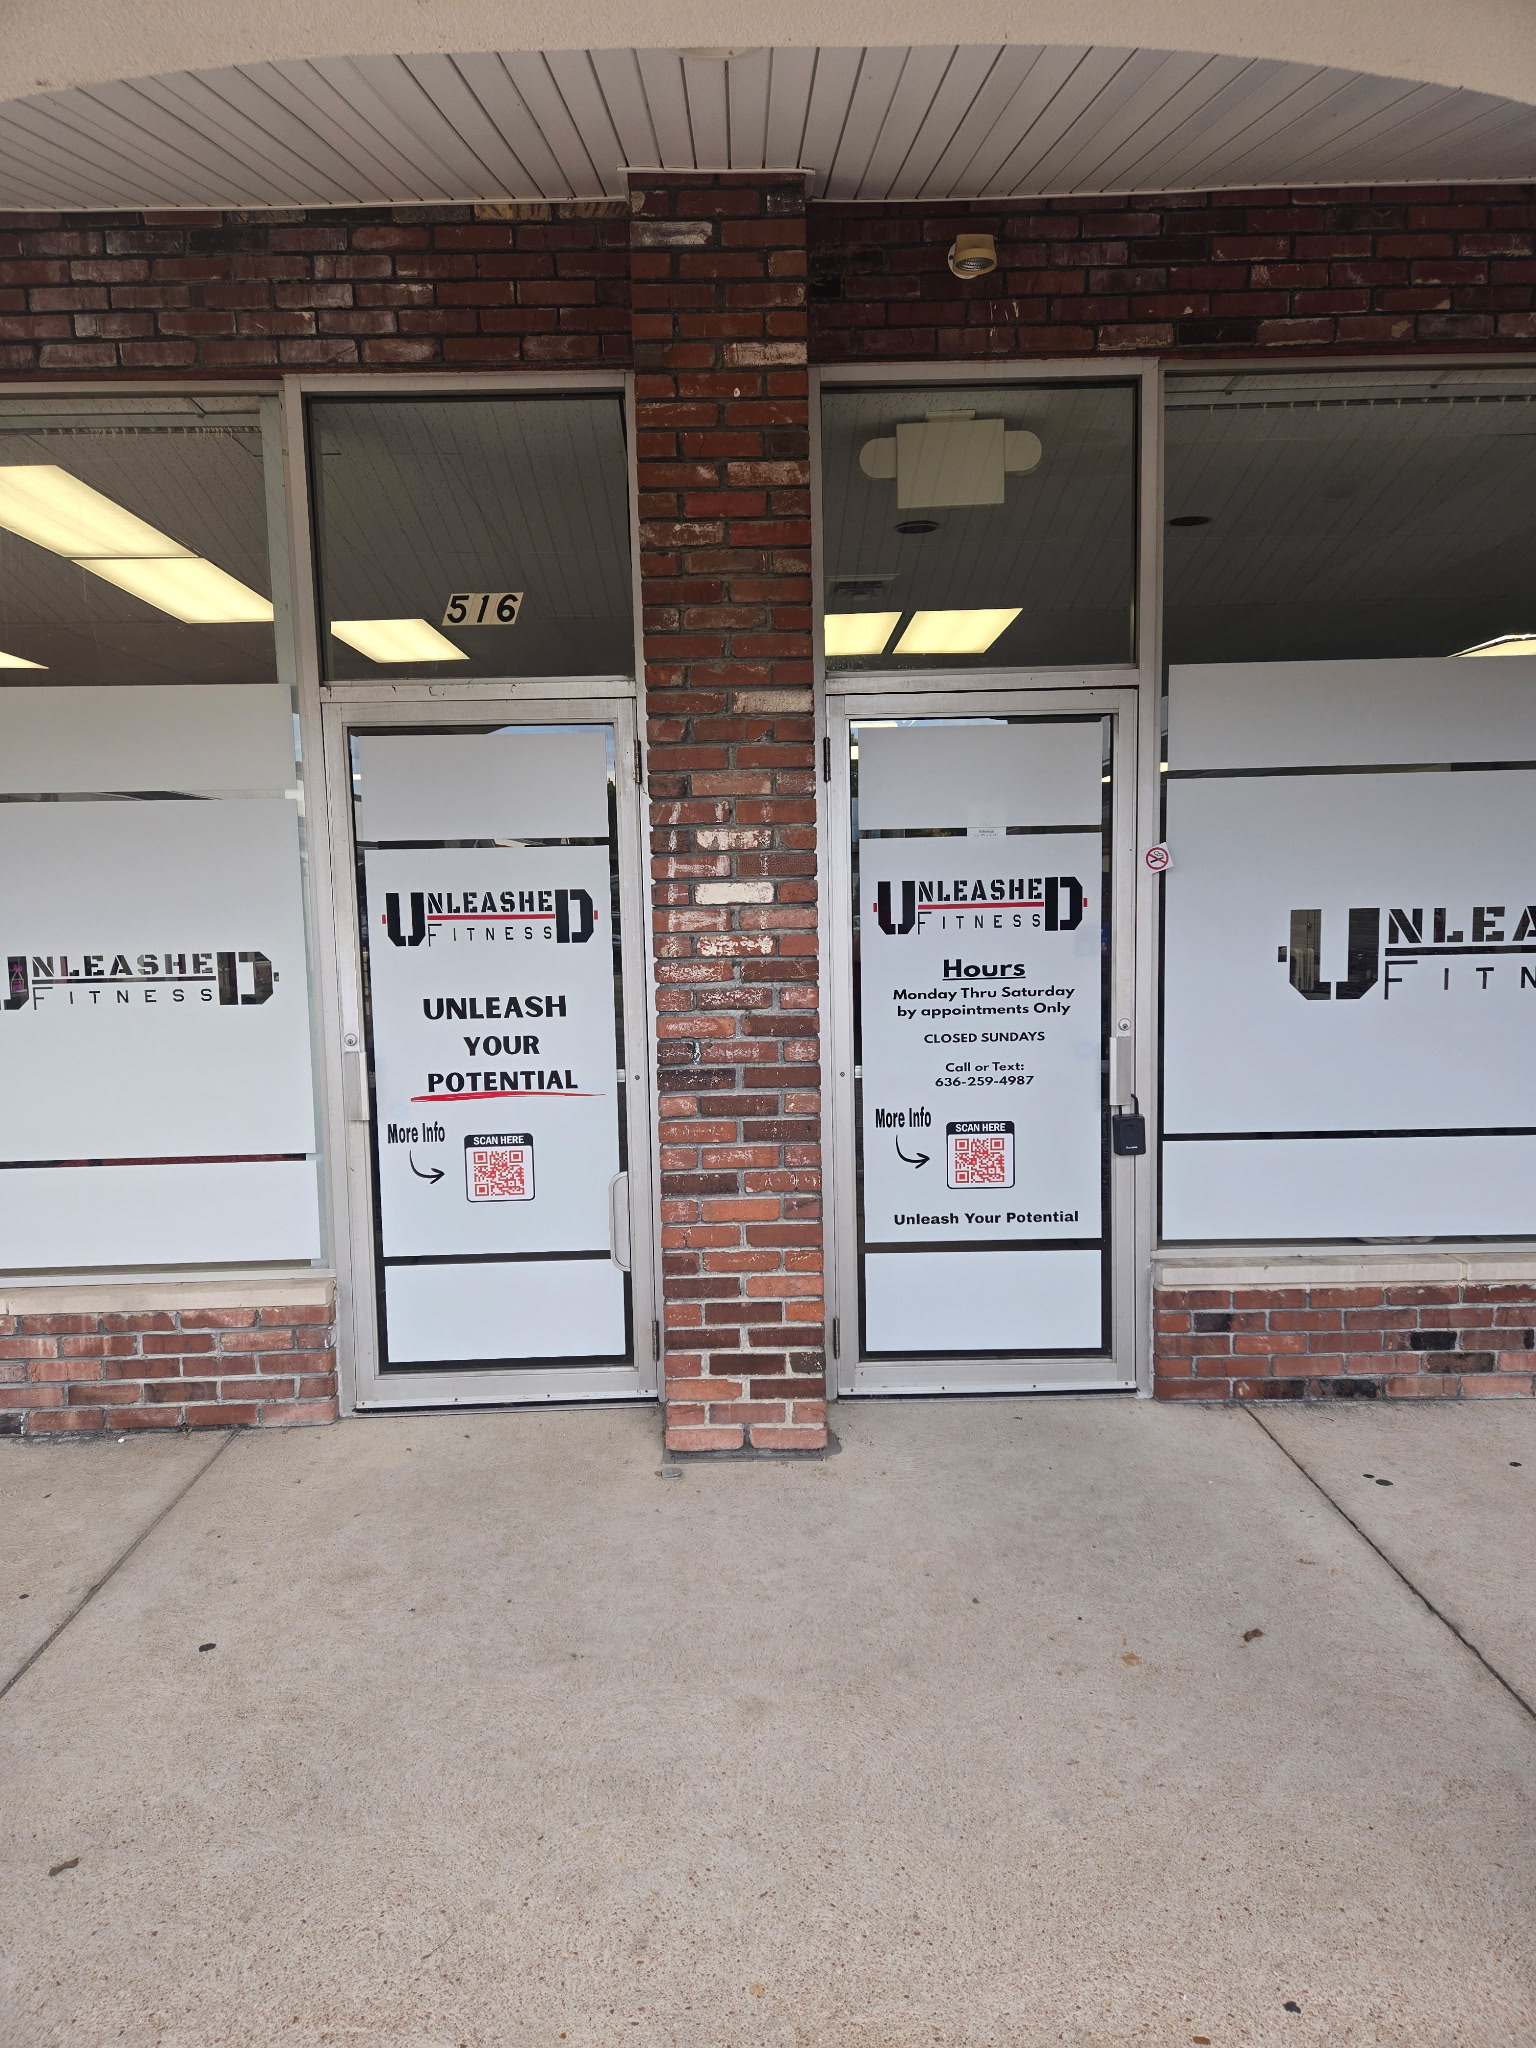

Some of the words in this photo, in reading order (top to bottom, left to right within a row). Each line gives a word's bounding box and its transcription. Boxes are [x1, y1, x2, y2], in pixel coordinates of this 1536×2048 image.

[447, 594, 518, 623] 516
[877, 876, 1083, 935] UNLEASHED
[385, 889, 594, 947] UNLEASHED
[918, 912, 1040, 934] FITNESS
[428, 924, 552, 946] FITNESS
[943, 959, 1026, 978] Hours
[33, 987, 212, 1010] FITNESS
[893, 988, 957, 1001] Monday
[961, 987, 996, 998] Thru
[1002, 985, 1075, 998] Saturday
[423, 995, 566, 1020] UNLEASH
[898, 1006, 916, 1019] by
[921, 1005, 1029, 1018] appointments
[1034, 1002, 1070, 1015] Only
[463, 1036, 540, 1056] YOUR
[924, 1034, 977, 1043] CLOSED
[981, 1032, 1045, 1042] SUNDAYS
[946, 1062, 970, 1072] Call
[992, 1062, 1024, 1071] Text:
[428, 1070, 578, 1092] POTENTIAL
[936, 1076, 1034, 1086] 636-259-4987
[876, 1109, 905, 1128] More
[909, 1106, 931, 1127] Info
[956, 1123, 982, 1132] SCAN
[984, 1123, 1006, 1132] HERE
[388, 1124, 418, 1143] More
[423, 1121, 445, 1142] Info
[473, 1136, 499, 1145] SCAN
[501, 1136, 524, 1144] HERE
[895, 1213, 958, 1225] Unleash
[965, 1213, 1001, 1223] Your
[1007, 1211, 1078, 1223] Potential
